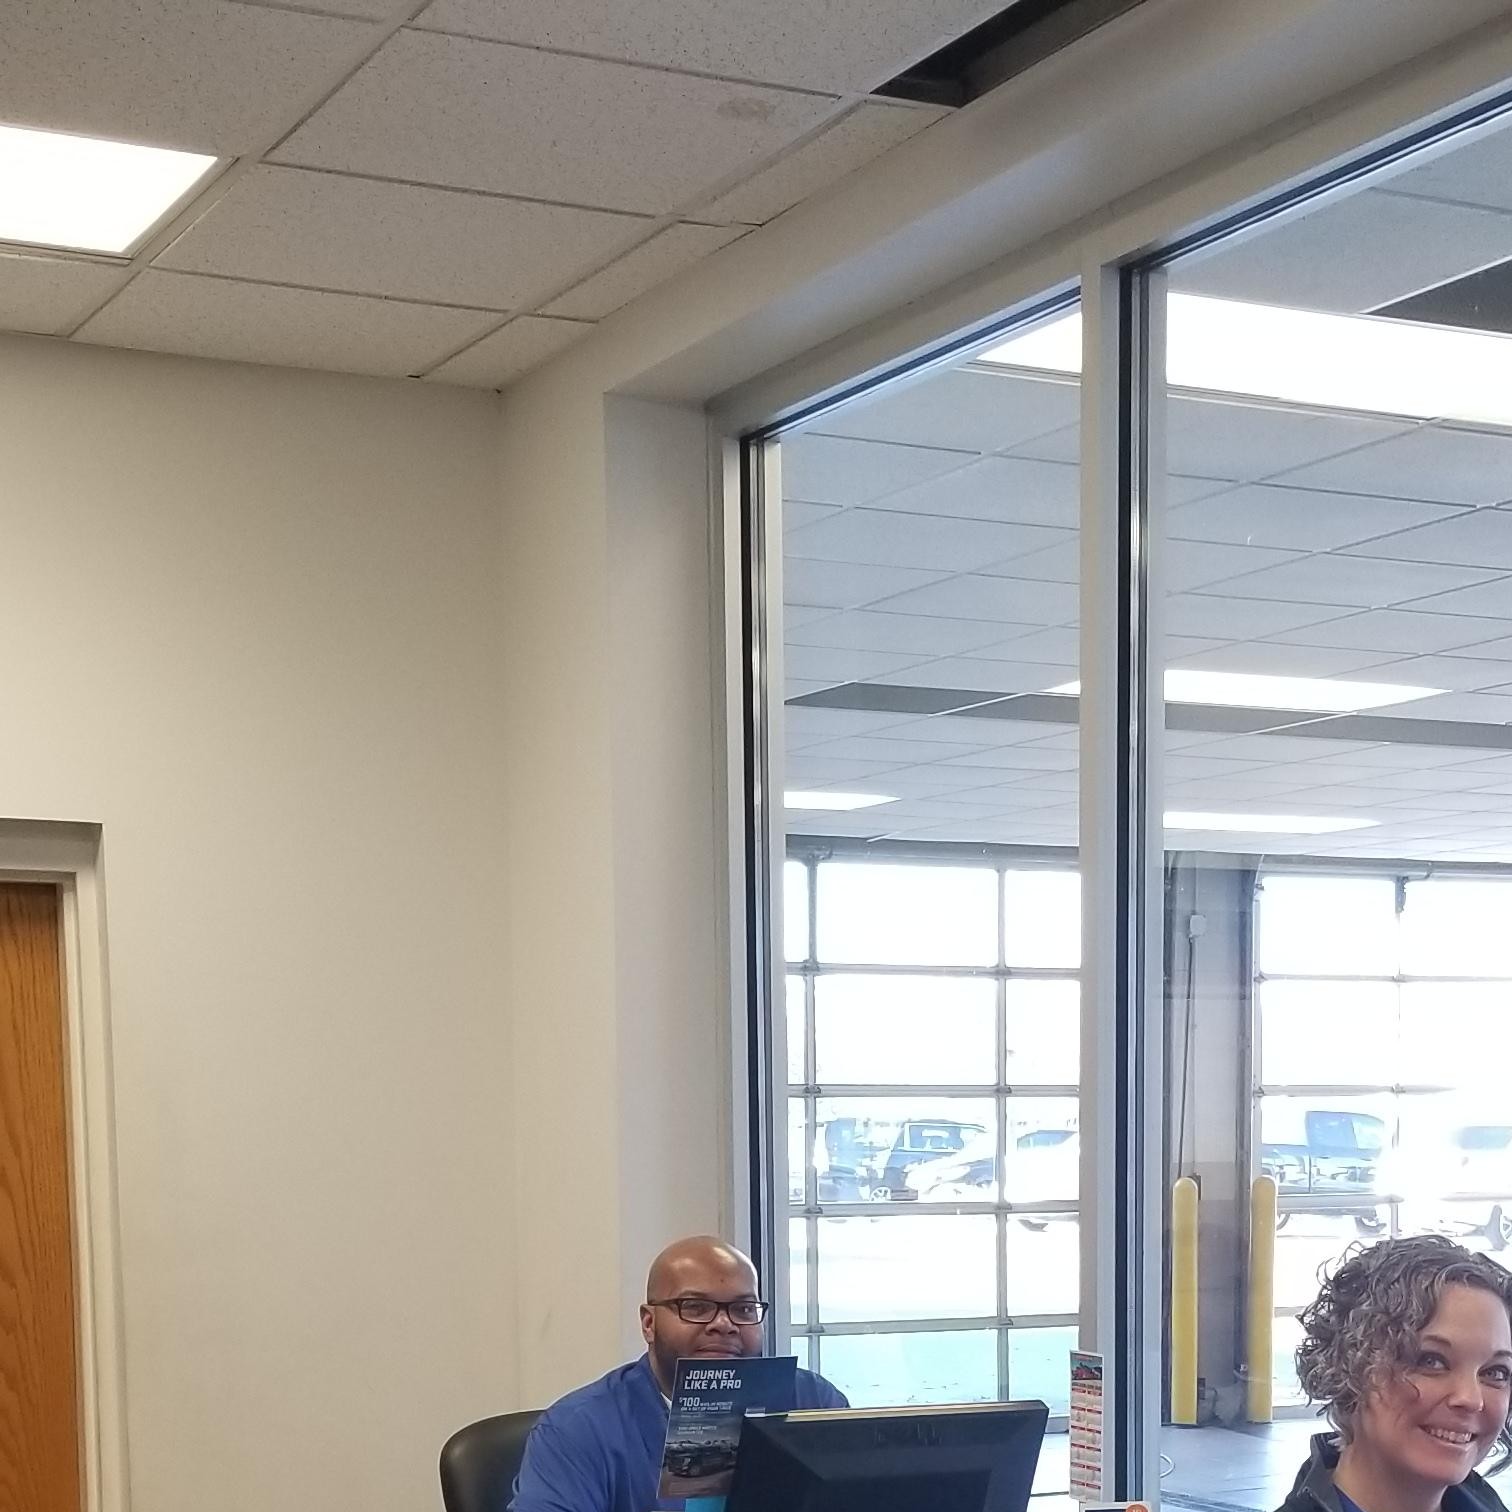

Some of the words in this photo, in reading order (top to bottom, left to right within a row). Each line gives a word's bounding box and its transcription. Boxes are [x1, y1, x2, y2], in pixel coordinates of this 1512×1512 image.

[685, 1370, 736, 1380] JOURNEY
[684, 1380, 708, 1390] LIKE
[710, 1381, 718, 1390] A
[720, 1379, 742, 1389] PRO
